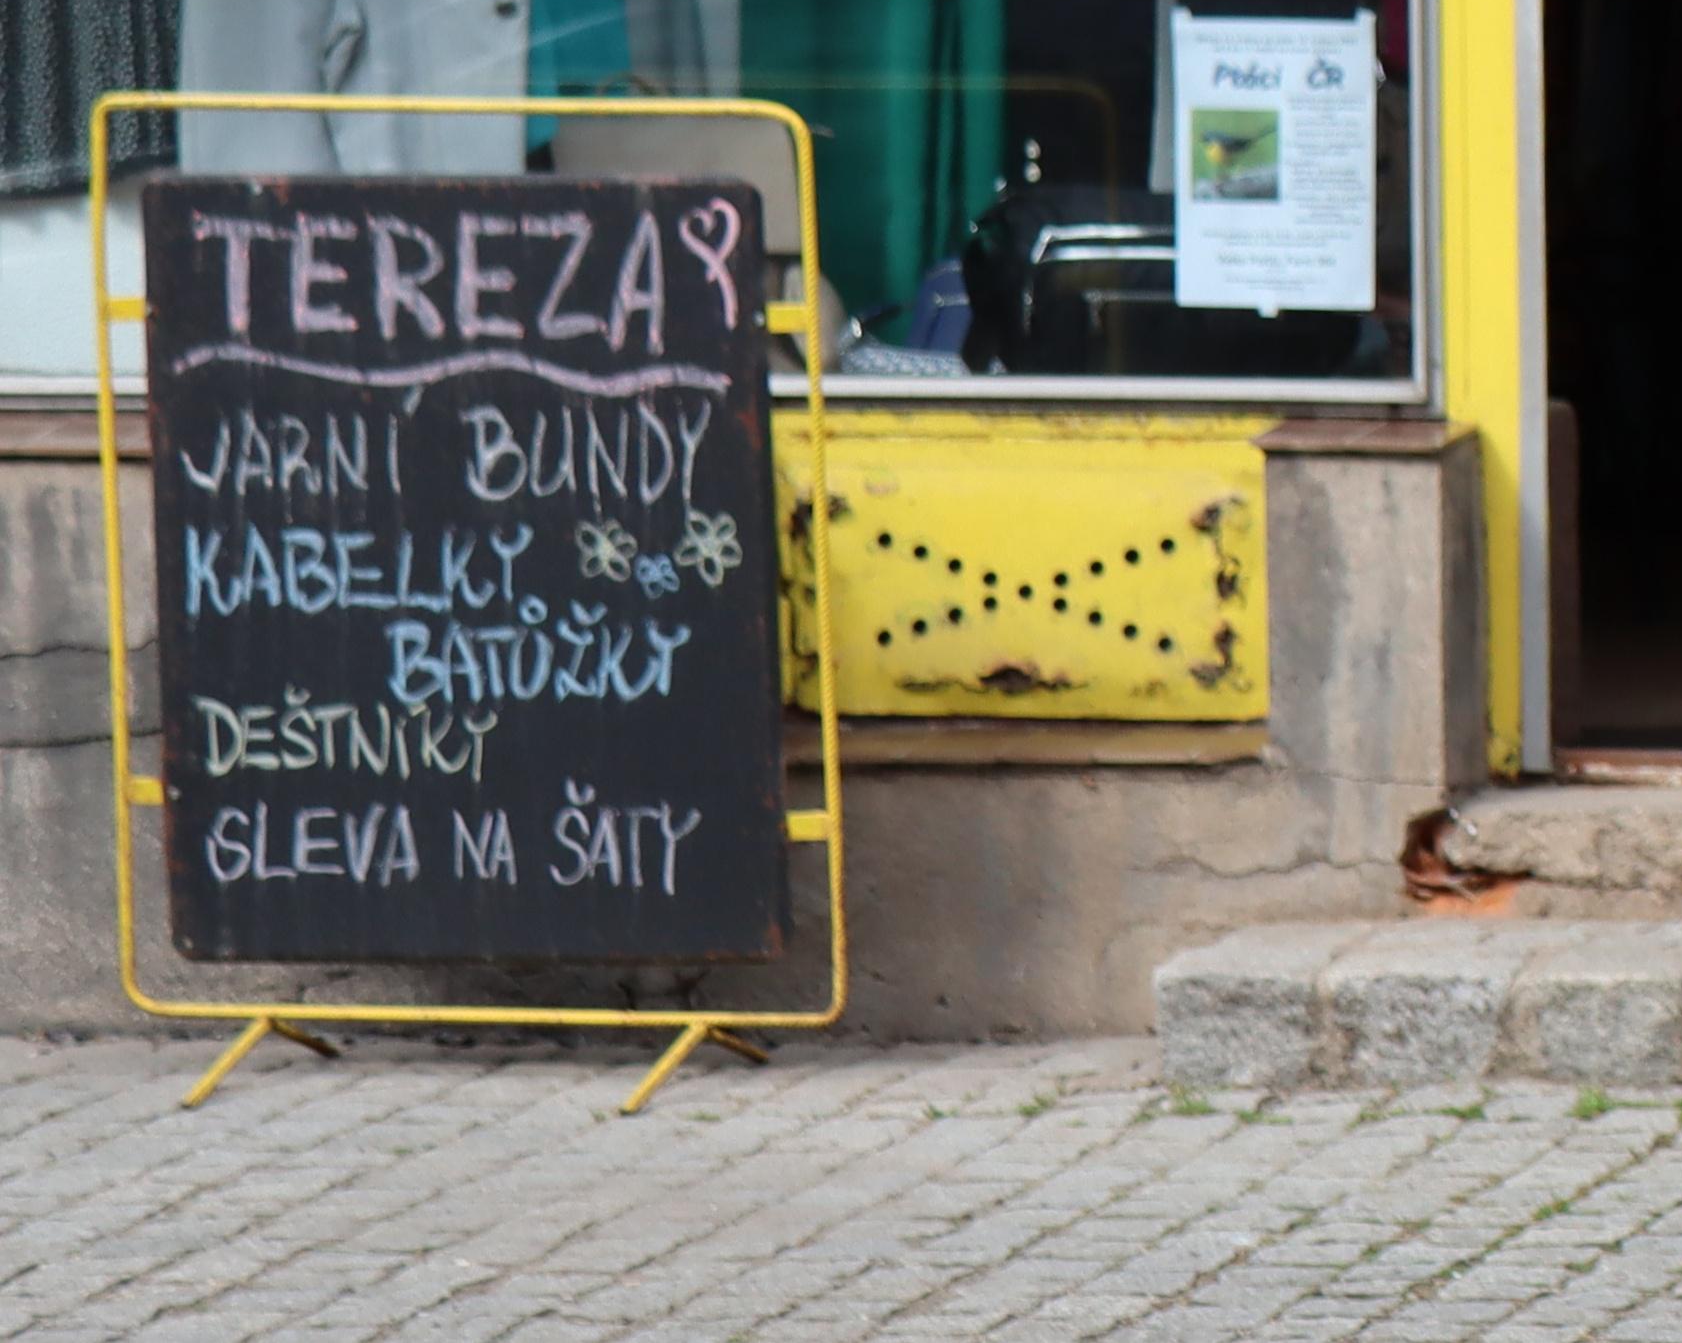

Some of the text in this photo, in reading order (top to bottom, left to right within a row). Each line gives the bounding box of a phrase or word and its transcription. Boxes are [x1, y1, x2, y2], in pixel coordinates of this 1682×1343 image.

[192, 209, 667, 355] TEREZA
[460, 400, 712, 513] BUNDY
[184, 523, 533, 617] KABELKY
[384, 595, 690, 703] BATŮŽKY
[205, 778, 701, 897] SLEVA NA ŠATY
